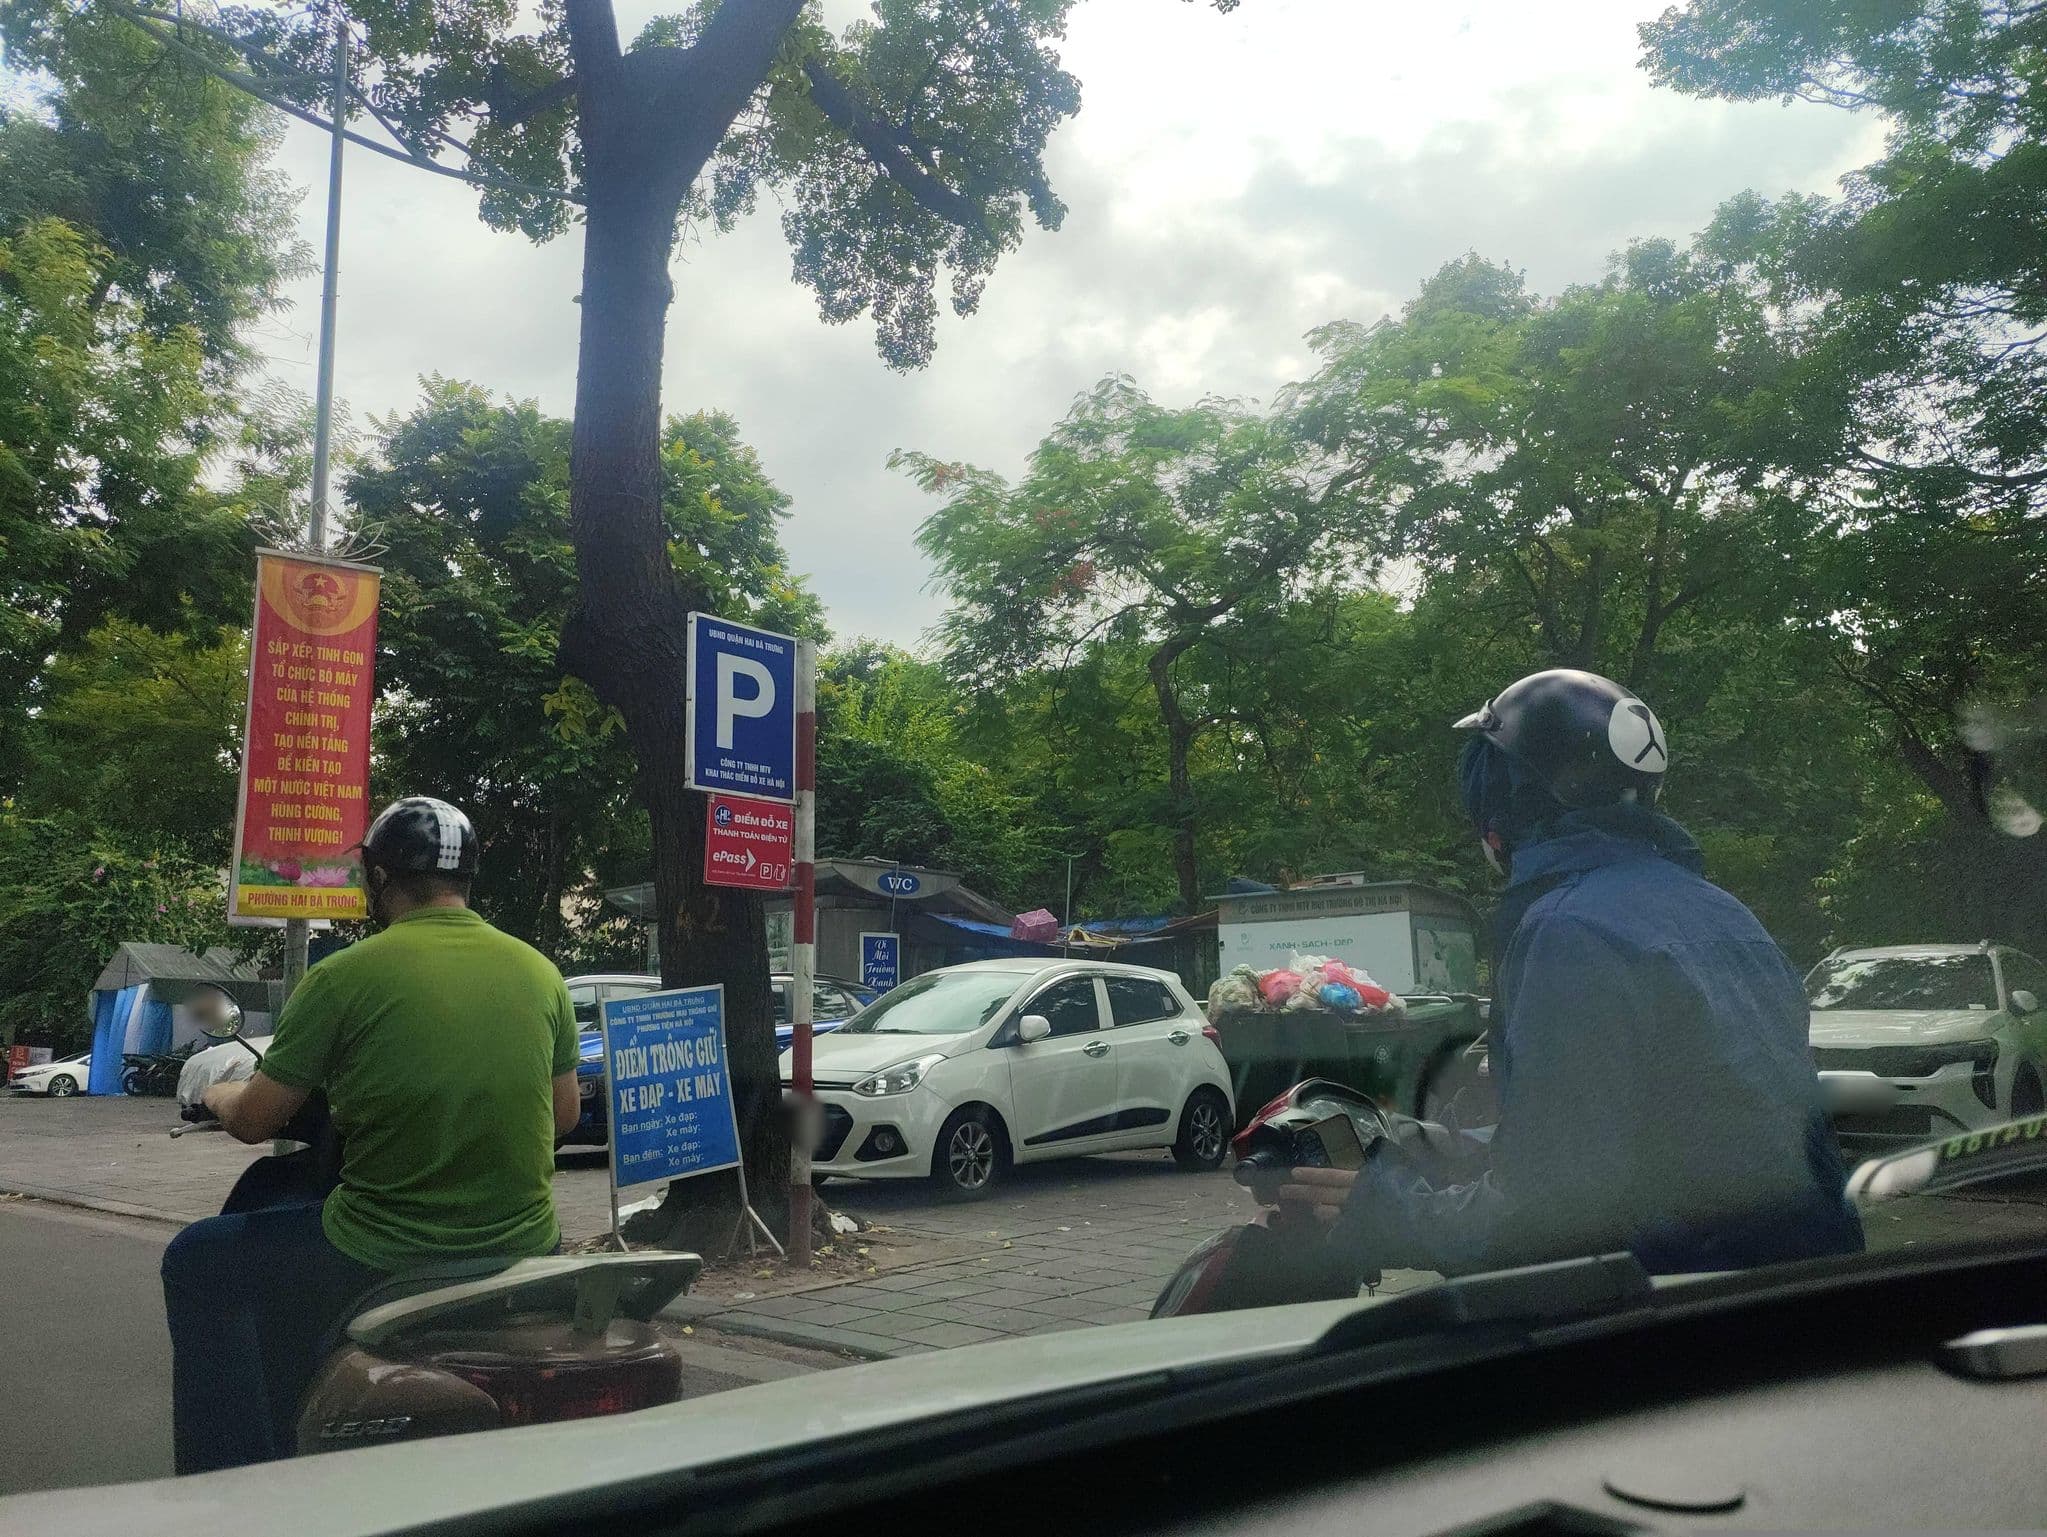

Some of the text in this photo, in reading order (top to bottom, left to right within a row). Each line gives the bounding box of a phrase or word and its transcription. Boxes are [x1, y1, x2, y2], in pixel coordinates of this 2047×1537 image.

[708, 629, 783, 654] UBND QUẬN HAI BÀ TRƯNG
[268, 636, 289, 656] SẮP
[317, 647, 340, 662] TINH
[343, 650, 364, 667] GỌN
[272, 660, 358, 687] TỔ CHỨC BỘ MÁY
[277, 683, 351, 708] CỦA HỆ THỐNG
[717, 651, 776, 750] P
[285, 709, 317, 727] CHÍNH
[274, 733, 293, 750] TẠO
[322, 733, 349, 752] TẢNG
[277, 753, 342, 777] ĐỂ KIẾN TẠO
[720, 758, 771, 774] CÔNG TY TNHH MTV
[705, 768, 785, 789] KHAI THÁC ĐIỂM ĐỖ XE HÀ NỘI
[254, 777, 362, 800] MỘT NƯỚC VIỆT NAM
[271, 801, 301, 818] HÙNG
[735, 811, 788, 830] ĐIỂM ĐỖ XE
[268, 826, 300, 844] THỊNH
[713, 828, 739, 838] THANH
[741, 831, 760, 840] TOÁN
[761, 833, 777, 843] ĐIỆN
[713, 850, 747, 864] ePass
[887, 876, 913, 891] WC
[248, 890, 357, 908] PHƯỜNG HAI BÀ TRƯNG
[1269, 941, 1296, 950] XANH
[622, 1004, 641, 1013] UBND
[661, 999, 673, 1008] HAI
[610, 1017, 626, 1025] CÔNG
[627, 1016, 634, 1024] TY
[636, 1014, 651, 1022] TNHH
[652, 1010, 675, 1020] THƯƠNG
[637, 1023, 660, 1032] PHƯƠNG
[661, 1021, 674, 1030] TIỆN
[674, 1019, 682, 1027] HÀ
[615, 1026, 718, 1080] ĐIỂM TRÔNG GIỮ
[619, 1087, 636, 1113] XE
[639, 1083, 664, 1113] ĐẠP
[676, 1077, 693, 1103] XE
[694, 1069, 721, 1099] MÁY
[621, 1123, 639, 1134] Ban
[665, 1114, 676, 1125] Xe
[678, 1111, 698, 1122] đạp:
[666, 1124, 701, 1138] Xe máy:
[623, 1154, 640, 1164] Ban
[667, 1144, 679, 1155] Xe
[681, 1140, 701, 1151] đạp:
[668, 1153, 704, 1168] Xe máy:
